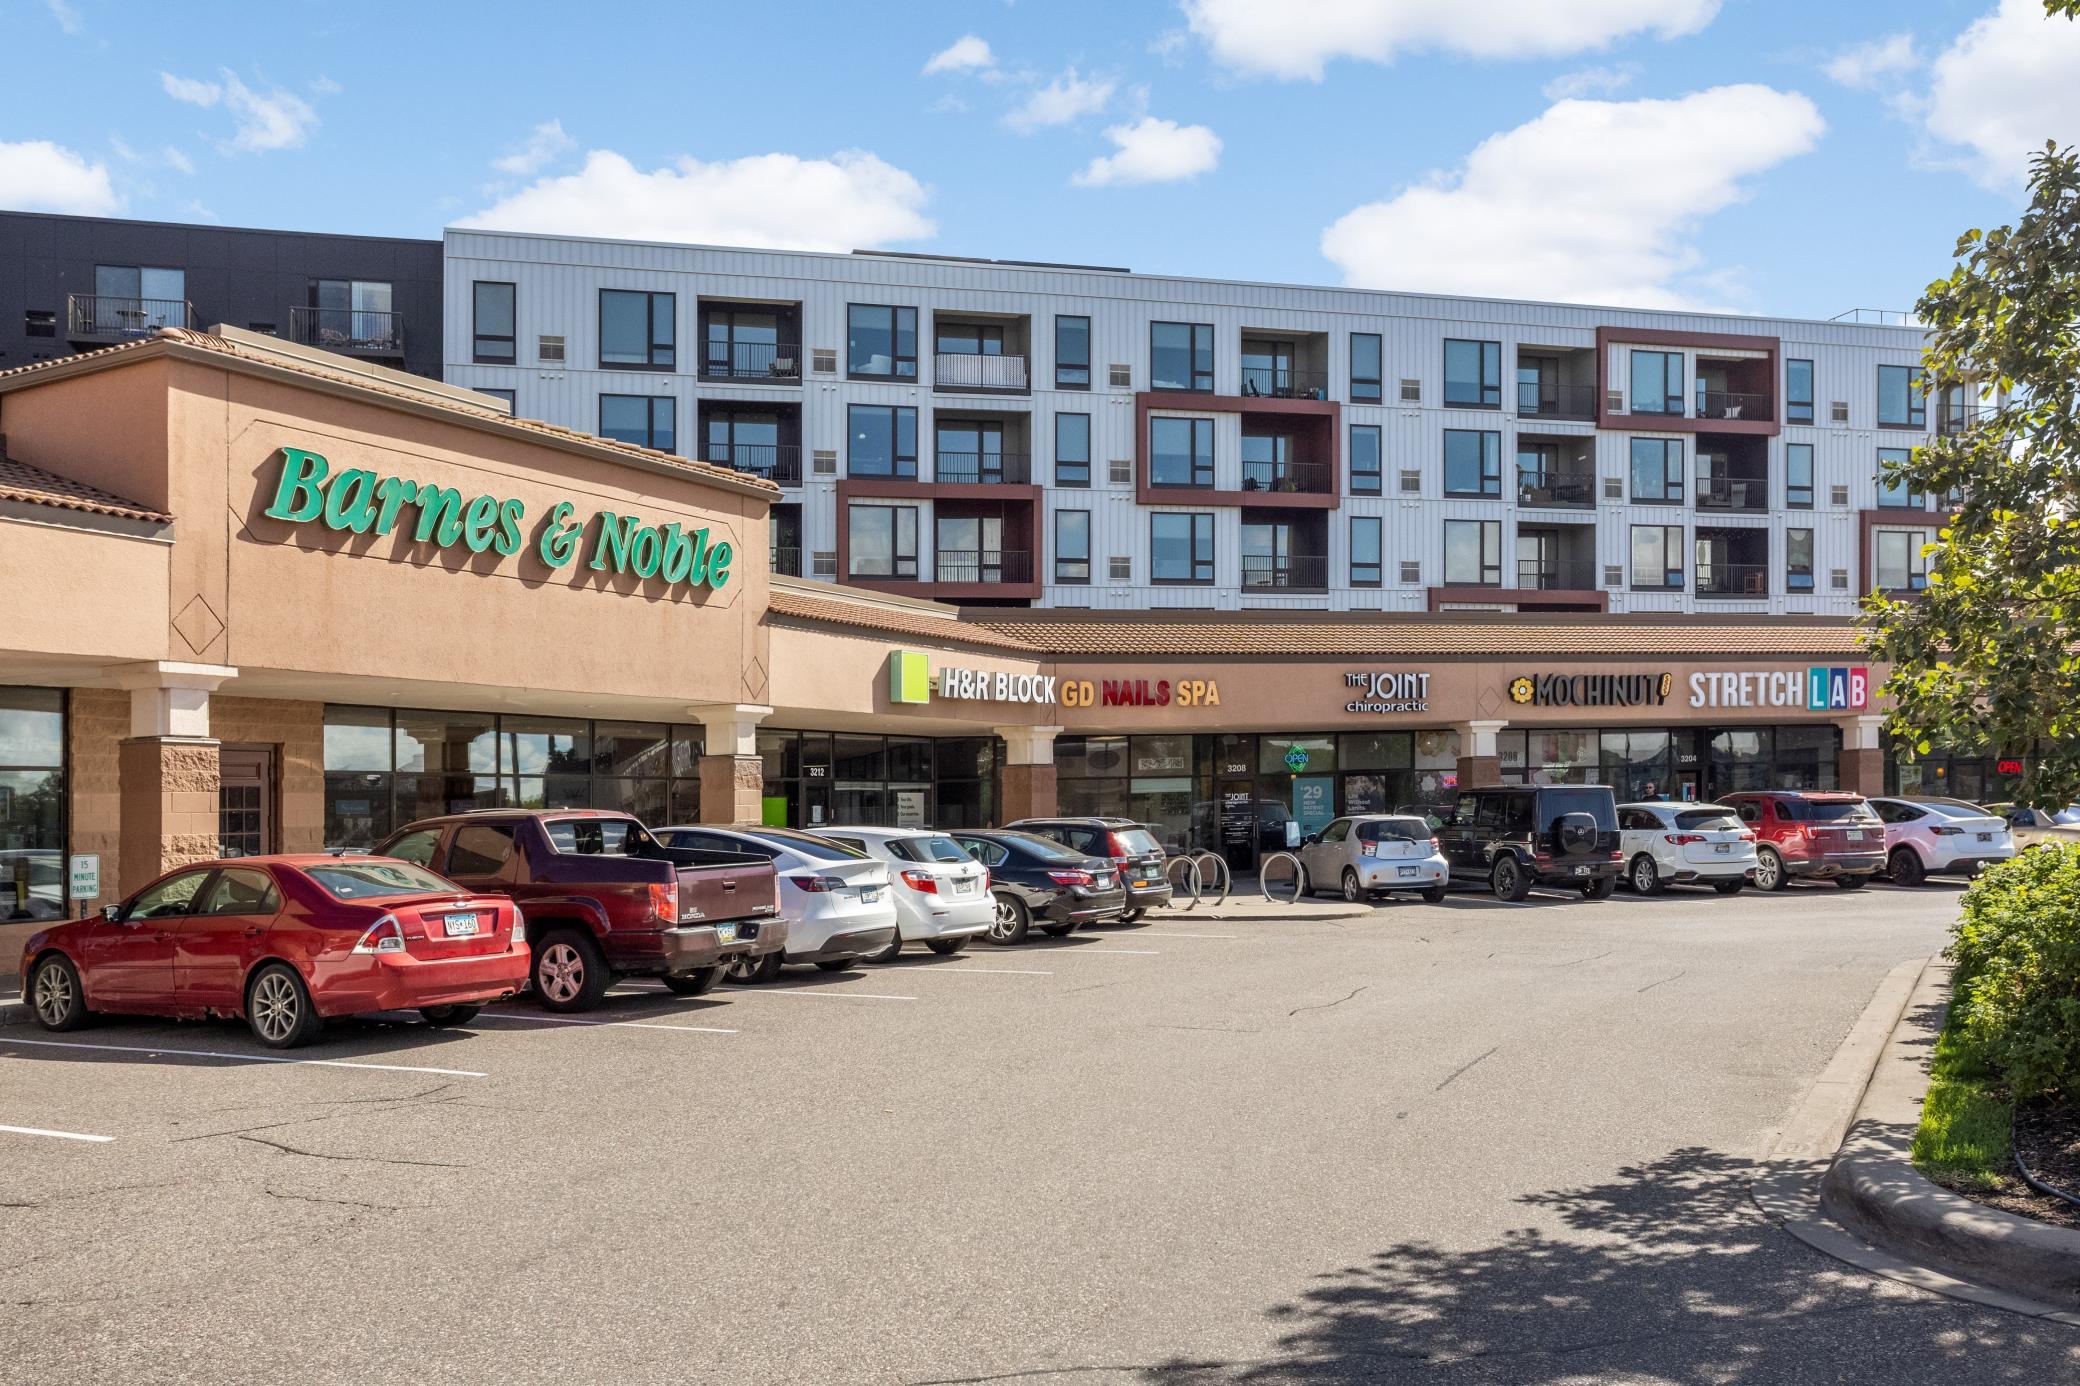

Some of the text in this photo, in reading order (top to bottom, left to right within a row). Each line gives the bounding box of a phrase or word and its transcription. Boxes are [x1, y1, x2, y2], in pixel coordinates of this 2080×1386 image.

[264, 446, 734, 591] Barnes & Noble
[942, 667, 1057, 704] H&R BLOCK
[1344, 672, 1431, 700] THE JOINT
[1060, 680, 1221, 707] GD NAILS SPA
[1345, 700, 1430, 714] chiropractic
[1285, 753, 1309, 763] OPEN
[1680, 754, 1697, 763] 3204
[1227, 764, 1247, 772] 3208
[1999, 760, 2022, 773] OPEN
[810, 767, 825, 777] 3212
[80, 860, 89, 869] 15
[73, 872, 96, 881] MINUTE
[72, 885, 97, 894] PARKING
